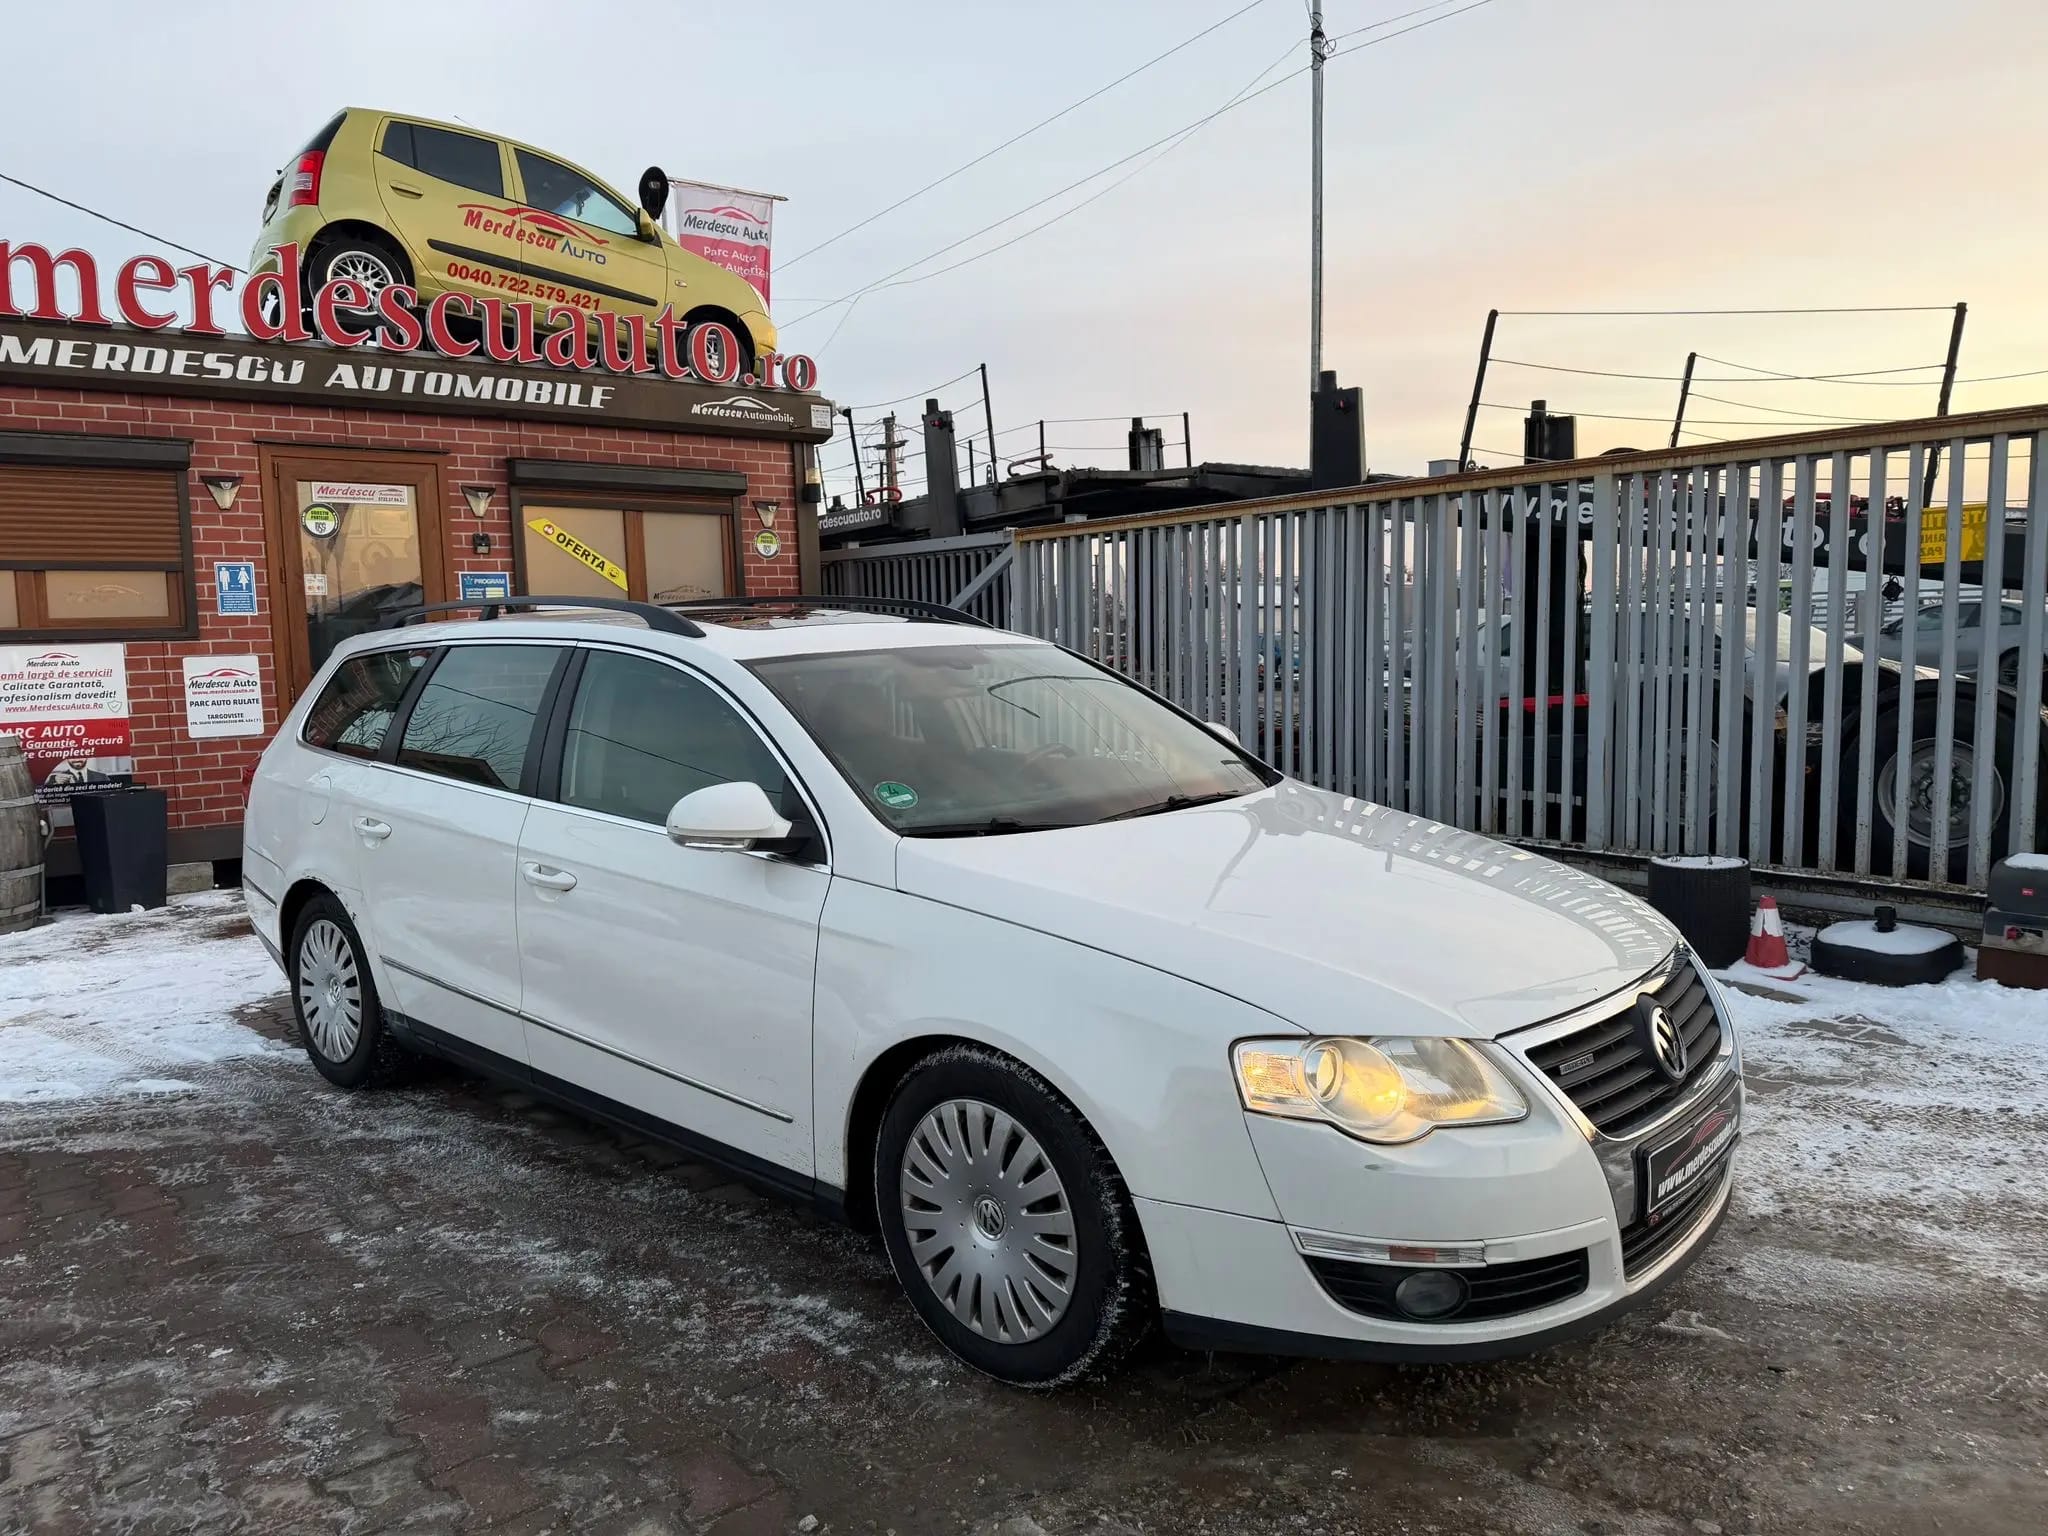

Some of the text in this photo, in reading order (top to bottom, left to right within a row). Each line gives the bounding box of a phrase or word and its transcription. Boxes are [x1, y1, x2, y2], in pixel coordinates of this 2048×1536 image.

[463, 209, 557, 251] Merdescu
[684, 214, 739, 236] Merdescu
[703, 246, 757, 263] Parc Auto
[447, 262, 601, 312] 0040.722.579.421
[0, 239, 818, 393] merdescuauto.ro
[1, 334, 616, 410] MERDESCU AUTOMOBILE
[317, 485, 377, 497] Merdescu
[818, 508, 882, 530] rdescuauto.ro
[555, 532, 606, 573] OFERTA
[26, 660, 58, 668] Merdescu
[58, 669, 69, 678] de
[73, 668, 113, 678] servicii!
[2, 682, 46, 691] Calitate
[188, 679, 258, 689] Merdescu Auto
[0, 690, 117, 704] rofesionalism dovedit!
[189, 700, 210, 708] PARC
[40, 724, 86, 738] AUTO
[38, 747, 95, 760] Complete!
